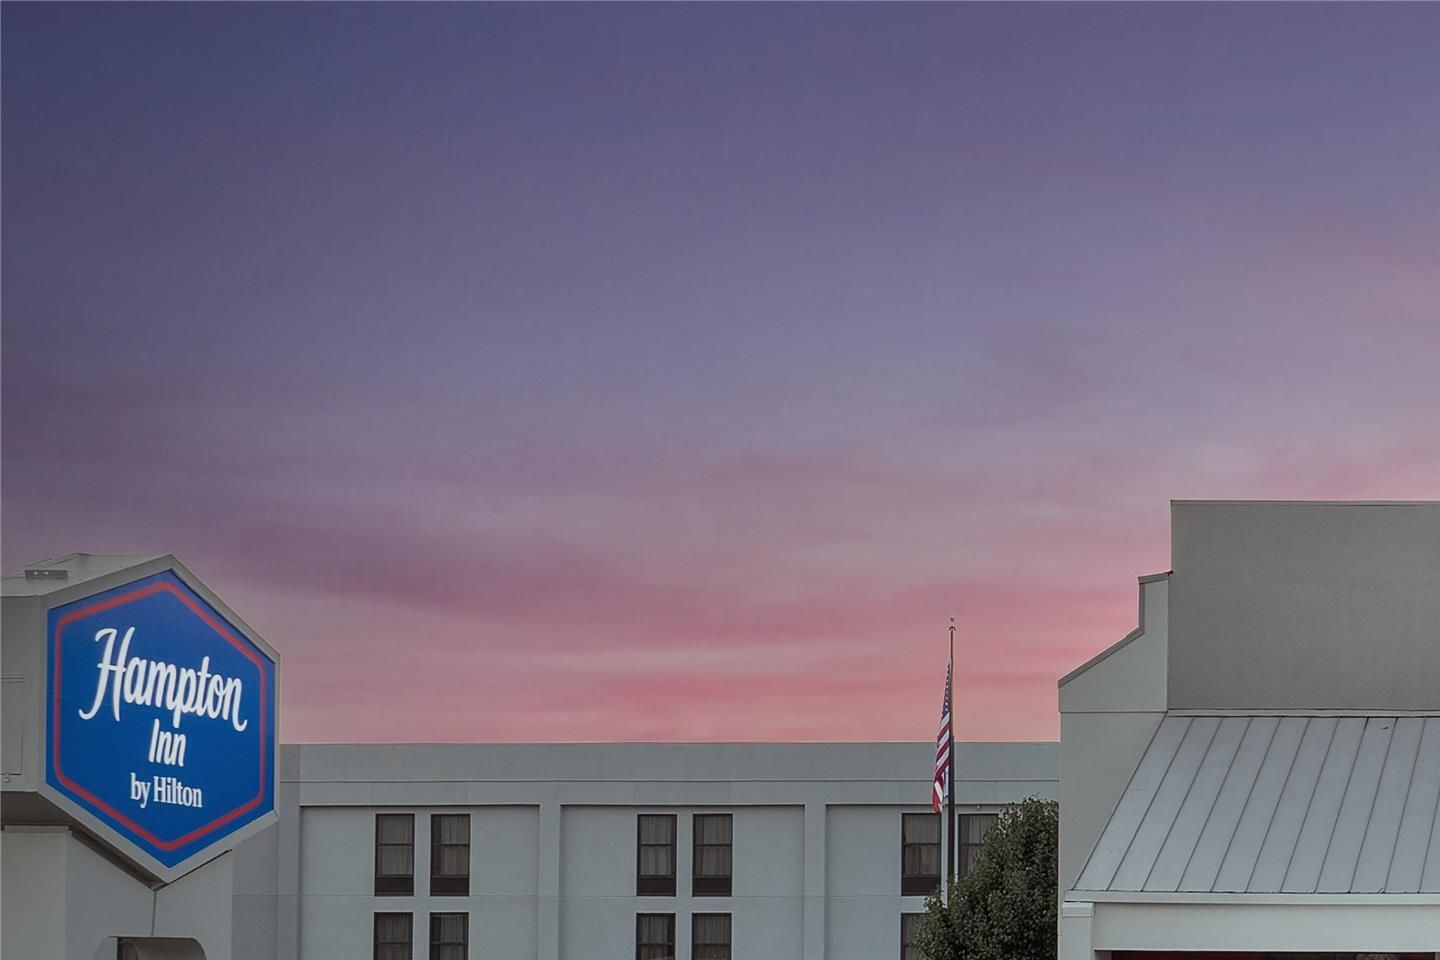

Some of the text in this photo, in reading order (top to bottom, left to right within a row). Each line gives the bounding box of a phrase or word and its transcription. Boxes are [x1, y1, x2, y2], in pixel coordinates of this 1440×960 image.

[78, 626, 248, 732] Hampton
[148, 718, 187, 767] Inn
[130, 772, 203, 808] by Hilton
